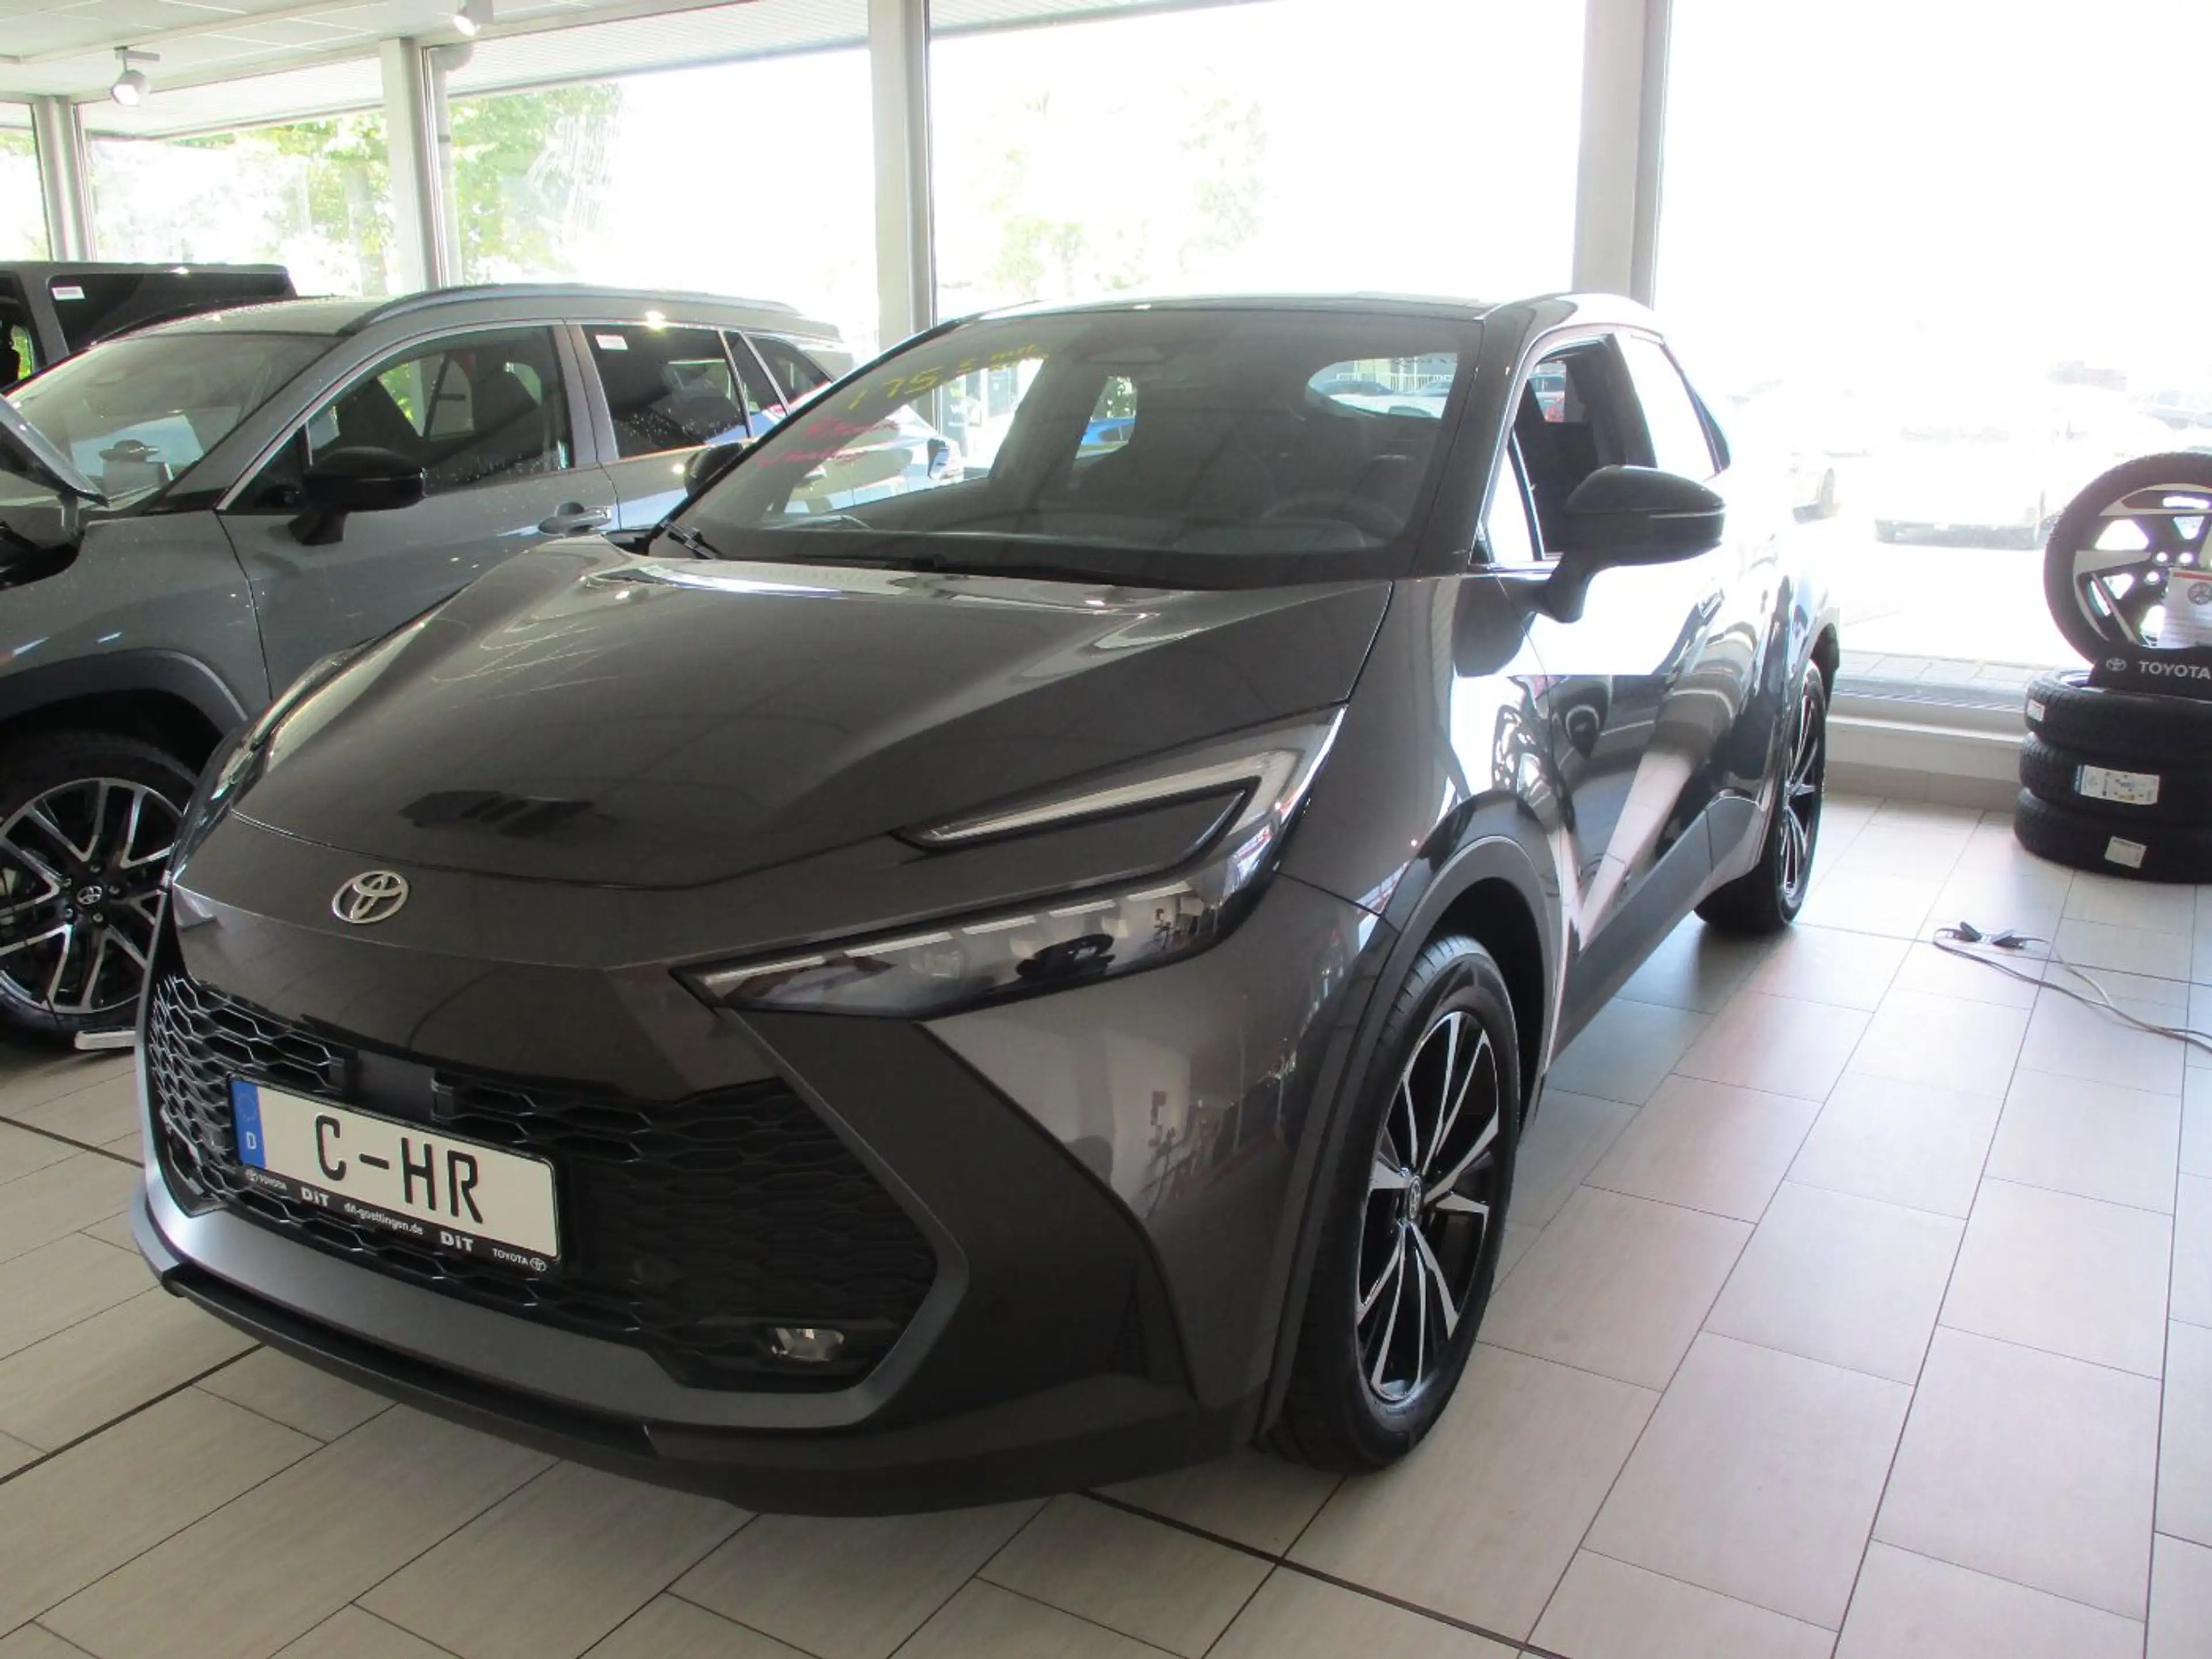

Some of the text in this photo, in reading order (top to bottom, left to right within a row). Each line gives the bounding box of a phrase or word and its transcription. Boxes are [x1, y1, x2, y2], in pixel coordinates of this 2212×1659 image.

[2139, 660, 2211, 680] TOYOTA
[246, 1131, 257, 1150] D
[315, 1115, 484, 1225] C-HR
[492, 1248, 529, 1266] TOYOTA
